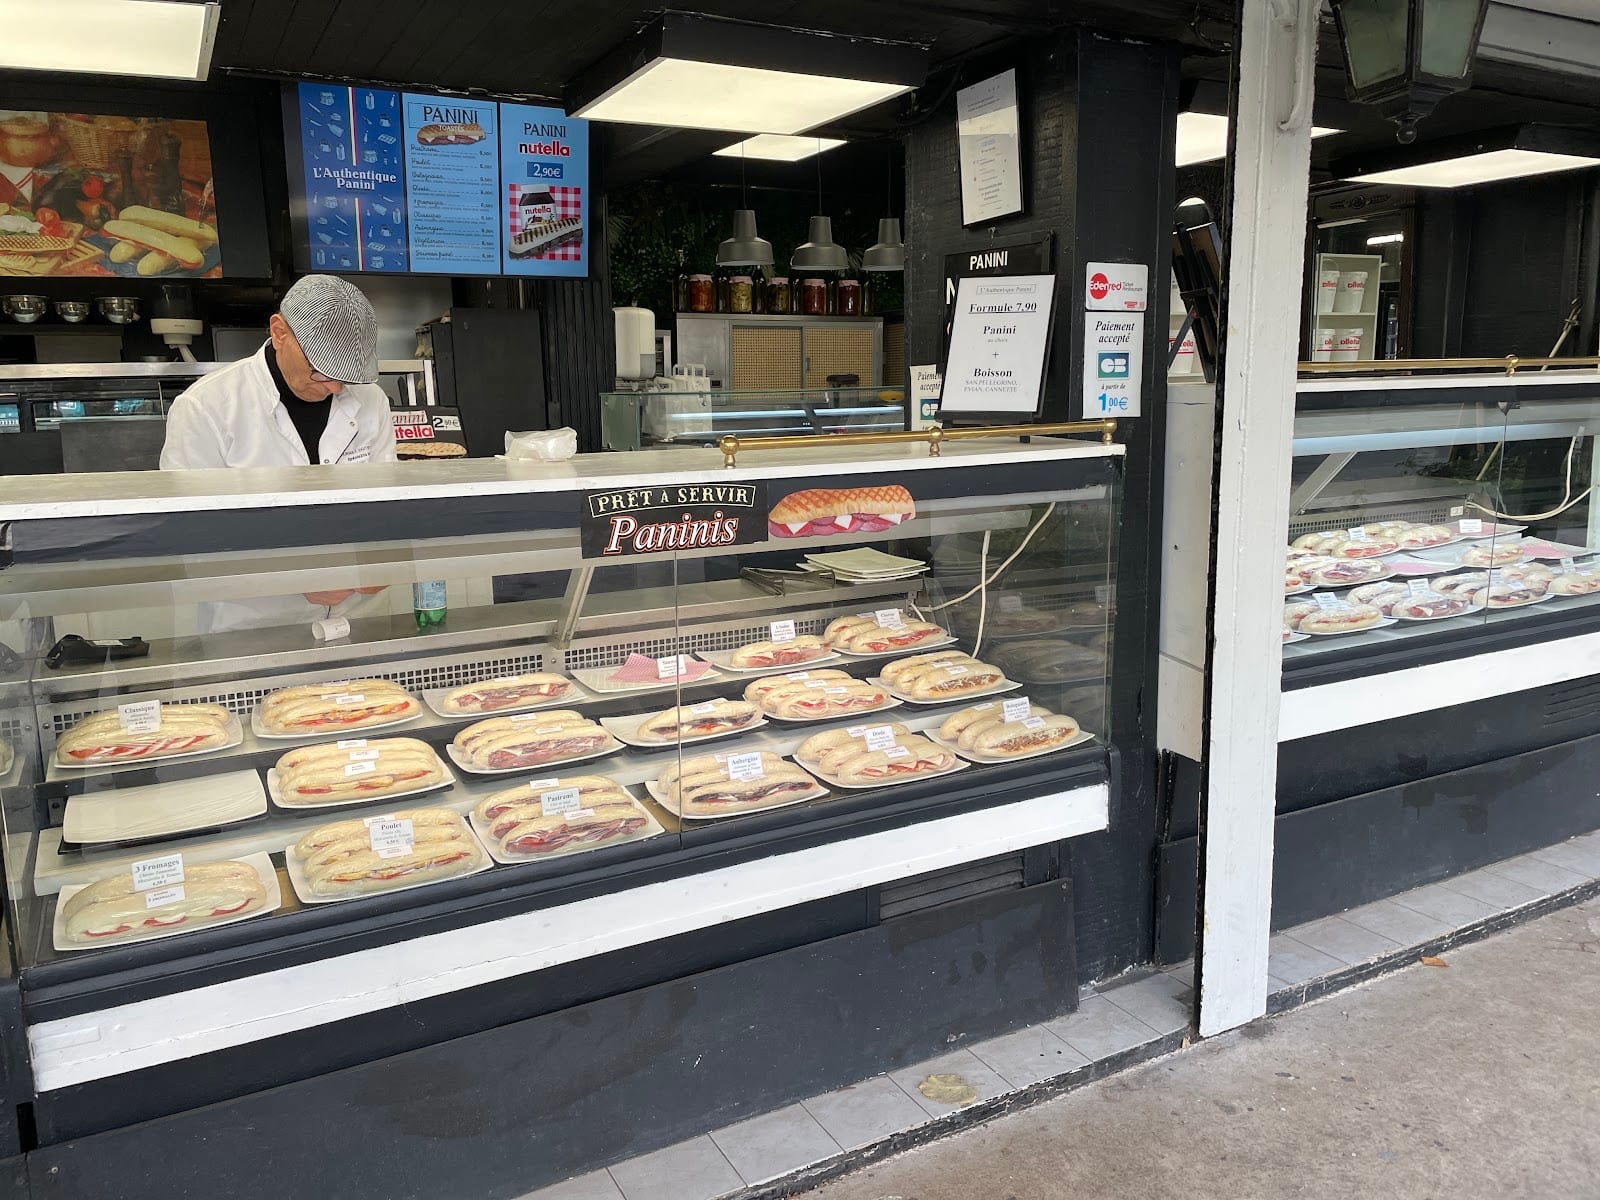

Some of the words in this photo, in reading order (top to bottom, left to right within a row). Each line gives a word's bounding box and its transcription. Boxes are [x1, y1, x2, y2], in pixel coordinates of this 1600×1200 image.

[423, 106, 478, 124] PANINI
[524, 123, 566, 138] PANINI
[519, 140, 570, 156] nutella
[313, 167, 397, 183] L'Authentique
[533, 163, 561, 178] 2,90€
[336, 178, 375, 190] Panini
[525, 205, 551, 215] nutella
[969, 250, 1009, 271] PANINI
[1090, 280, 1122, 291] Edenred
[969, 303, 1012, 313] Formule
[983, 325, 1017, 335] Panini
[1095, 320, 1135, 331] Paiement
[1098, 333, 1130, 345] accepté
[917, 371, 942, 381] Paiemen
[974, 368, 1013, 377] Boisson
[392, 411, 426, 424] anini
[395, 425, 433, 439] tella
[597, 490, 652, 513] PRÊT
[677, 487, 748, 504] SERVIR
[603, 510, 739, 554] Paninis
[381, 822, 402, 830] Poulet
[142, 860, 180, 872] Fromages
